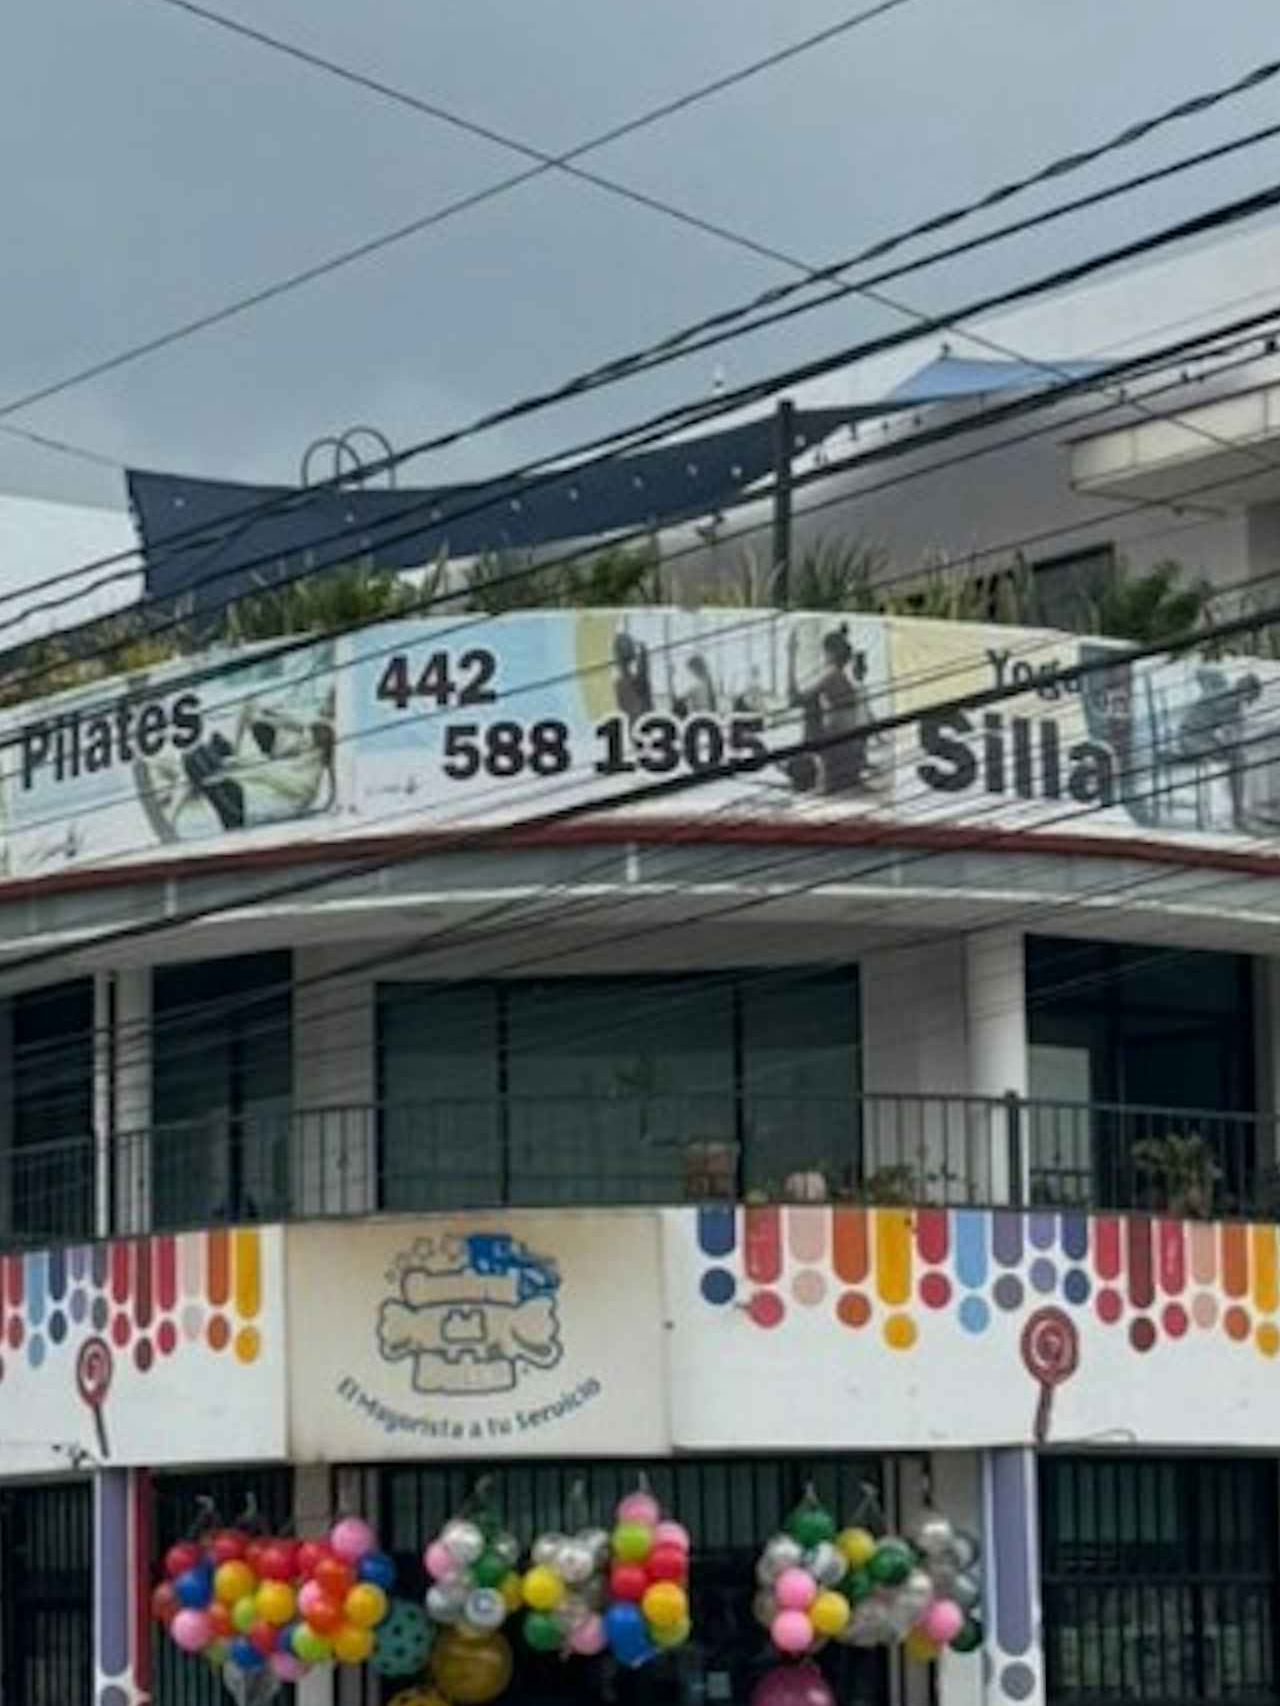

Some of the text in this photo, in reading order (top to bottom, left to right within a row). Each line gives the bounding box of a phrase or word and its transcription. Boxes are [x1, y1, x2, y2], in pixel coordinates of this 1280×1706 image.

[376, 649, 497, 710] 442
[986, 649, 1083, 701] Yoga
[22, 694, 204, 790] Pilates
[443, 716, 766, 782] 588 1305
[918, 707, 1115, 807] Silla
[487, 1415, 513, 1438] tu
